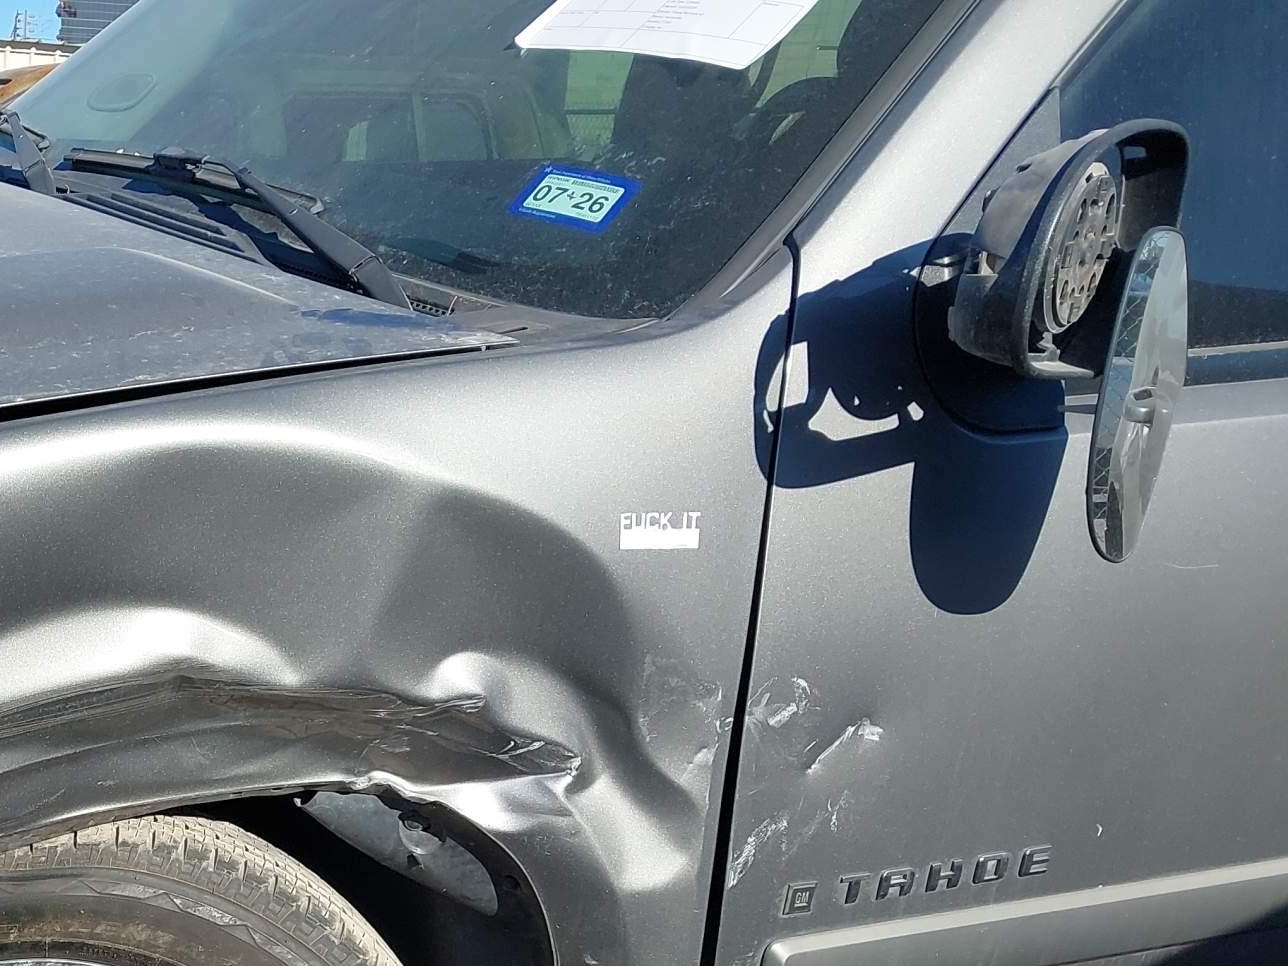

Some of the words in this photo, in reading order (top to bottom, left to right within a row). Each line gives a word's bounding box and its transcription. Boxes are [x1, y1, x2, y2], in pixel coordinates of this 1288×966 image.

[532, 184, 569, 204] 07
[571, 192, 610, 214] 26
[681, 510, 702, 530] IT
[795, 891, 810, 905] GM
[839, 845, 1053, 905] TAHOE
